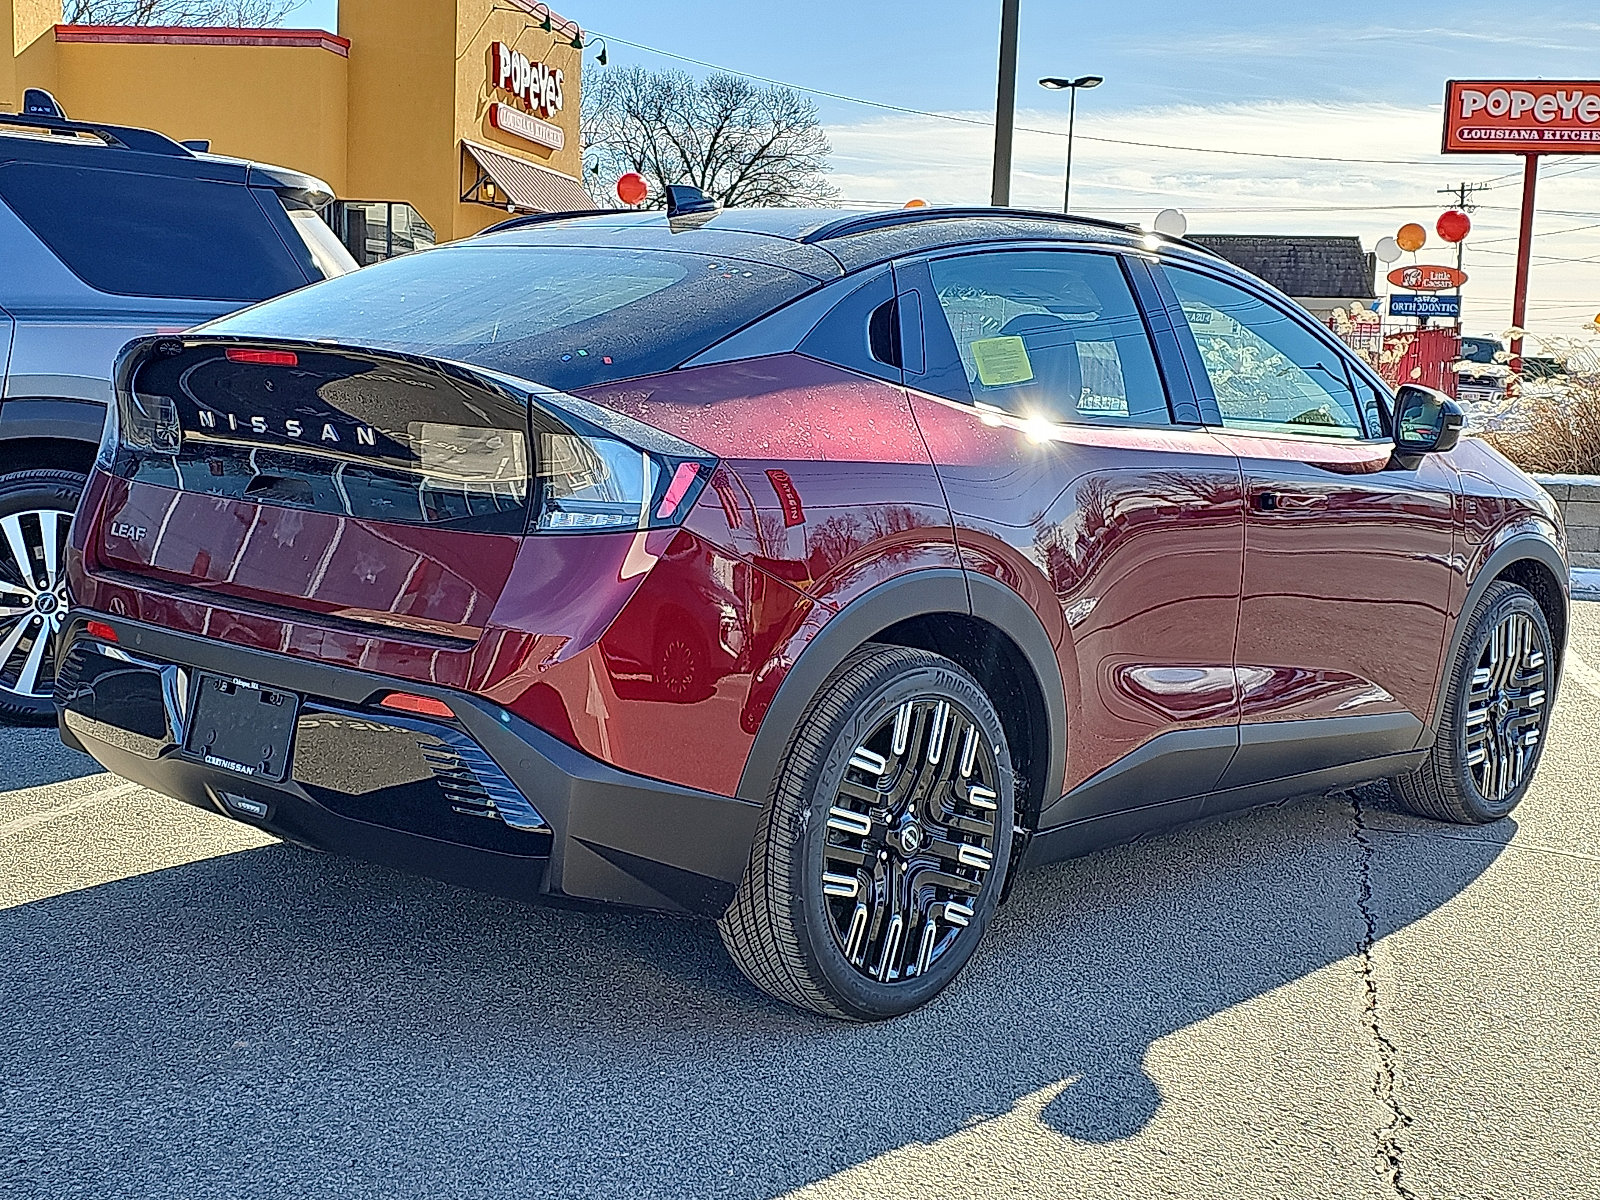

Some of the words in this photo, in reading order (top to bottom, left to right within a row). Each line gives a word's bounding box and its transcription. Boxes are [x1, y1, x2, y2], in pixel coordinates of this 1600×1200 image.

[1462, 129, 1540, 140] LOUISIANA
[1429, 271, 1451, 281] Little
[1423, 279, 1454, 288] Caesars
[199, 410, 377, 446] NISSAN
[110, 522, 147, 541] LEAF
[220, 759, 254, 775] NISSAN
